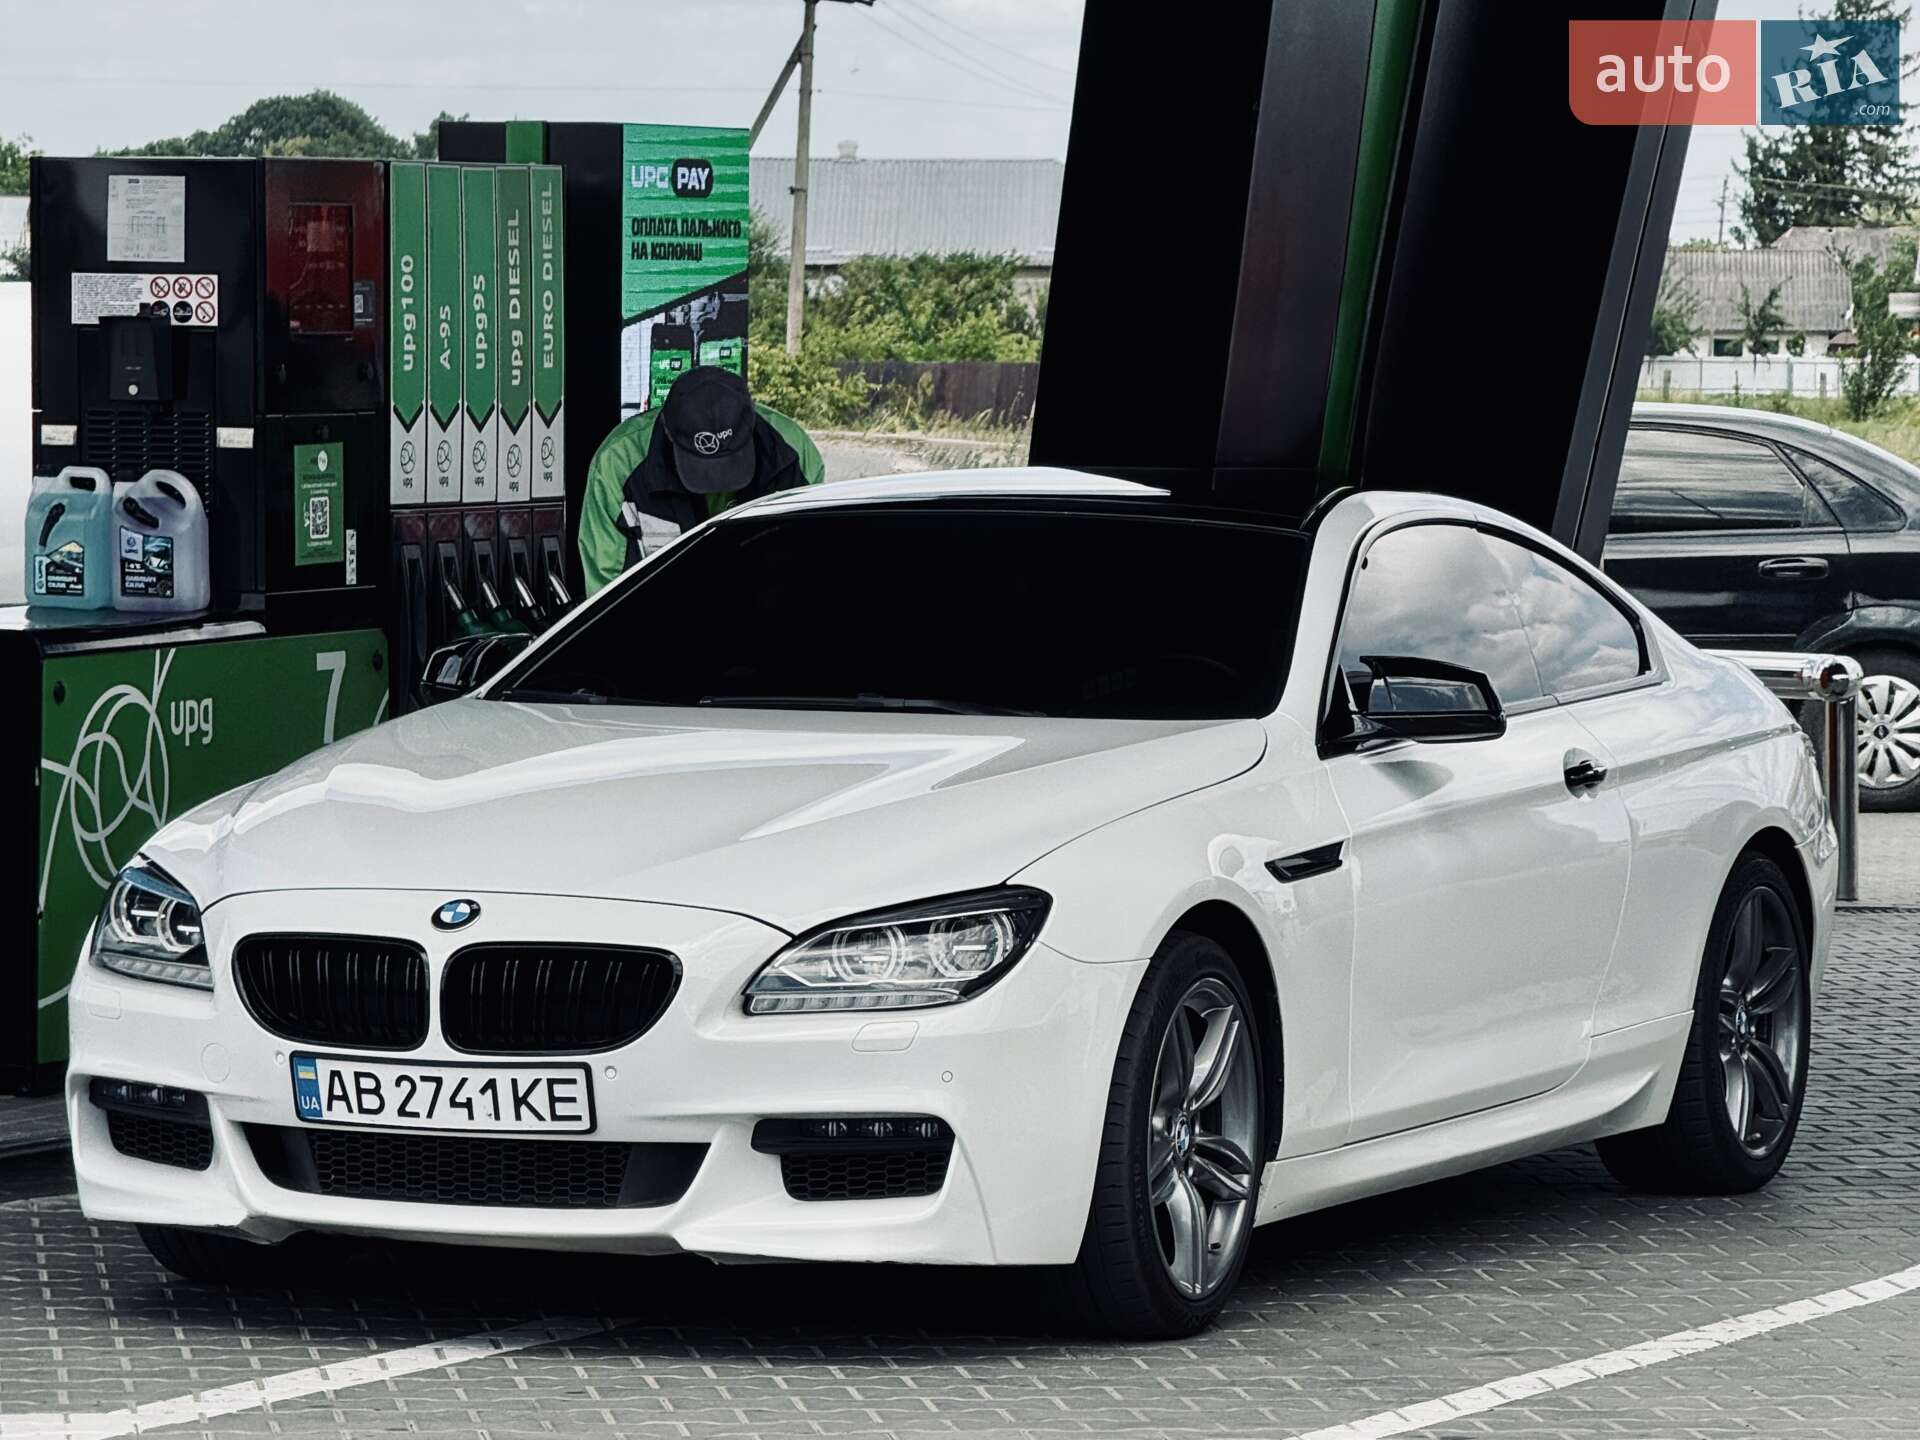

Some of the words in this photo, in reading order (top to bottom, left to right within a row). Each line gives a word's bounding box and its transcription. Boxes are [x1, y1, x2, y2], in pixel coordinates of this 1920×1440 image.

[631, 165, 669, 189] UPG
[677, 166, 710, 190] PAY
[541, 182, 553, 281] DIESEL
[631, 217, 679, 237] ОПЛАТА
[681, 217, 742, 238] ПАЛЬНОГО
[631, 241, 649, 260] НА
[507, 208, 521, 320] DIESEL
[542, 290, 554, 369] EURO
[511, 329, 524, 386] upg
[170, 697, 213, 747] upg
[315, 650, 347, 745] 7
[300, 1098, 321, 1112] UA
